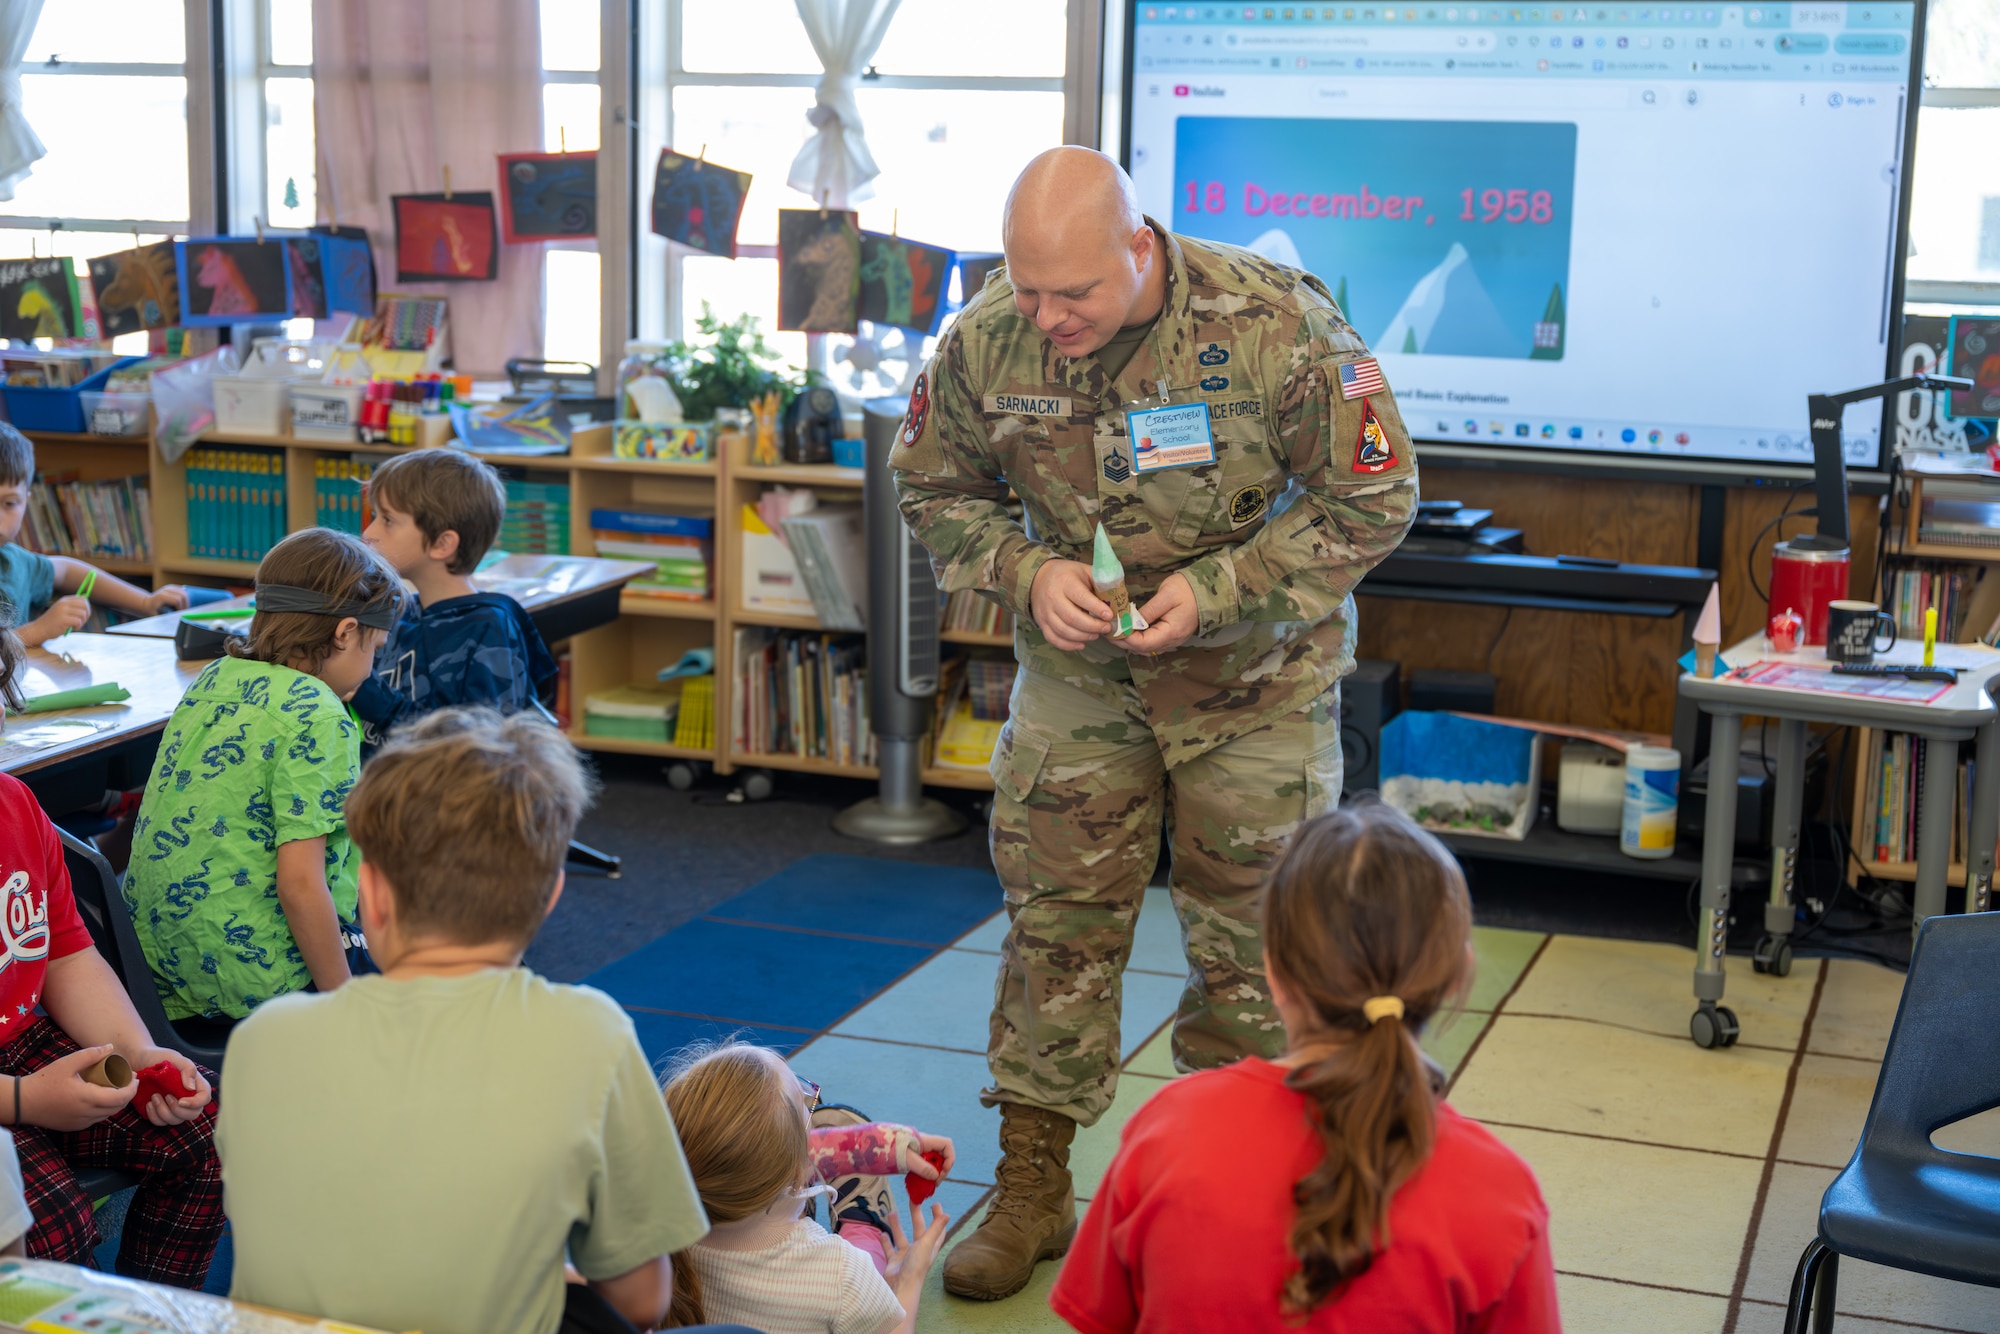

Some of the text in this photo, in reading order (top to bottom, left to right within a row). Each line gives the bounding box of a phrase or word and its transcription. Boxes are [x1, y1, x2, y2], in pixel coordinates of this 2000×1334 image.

[1191, 85, 1226, 98] YouTube
[1184, 180, 1554, 227] 18 December, 1958
[996, 396, 1059, 414] SARNACKI
[1447, 390, 1510, 404] Explanation
[1230, 400, 1261, 417] FORCE
[1150, 424, 1199, 436] Elementary
[1162, 434, 1190, 444] School
[1896, 425, 1970, 453] NASA
[1844, 623, 1869, 639] day
